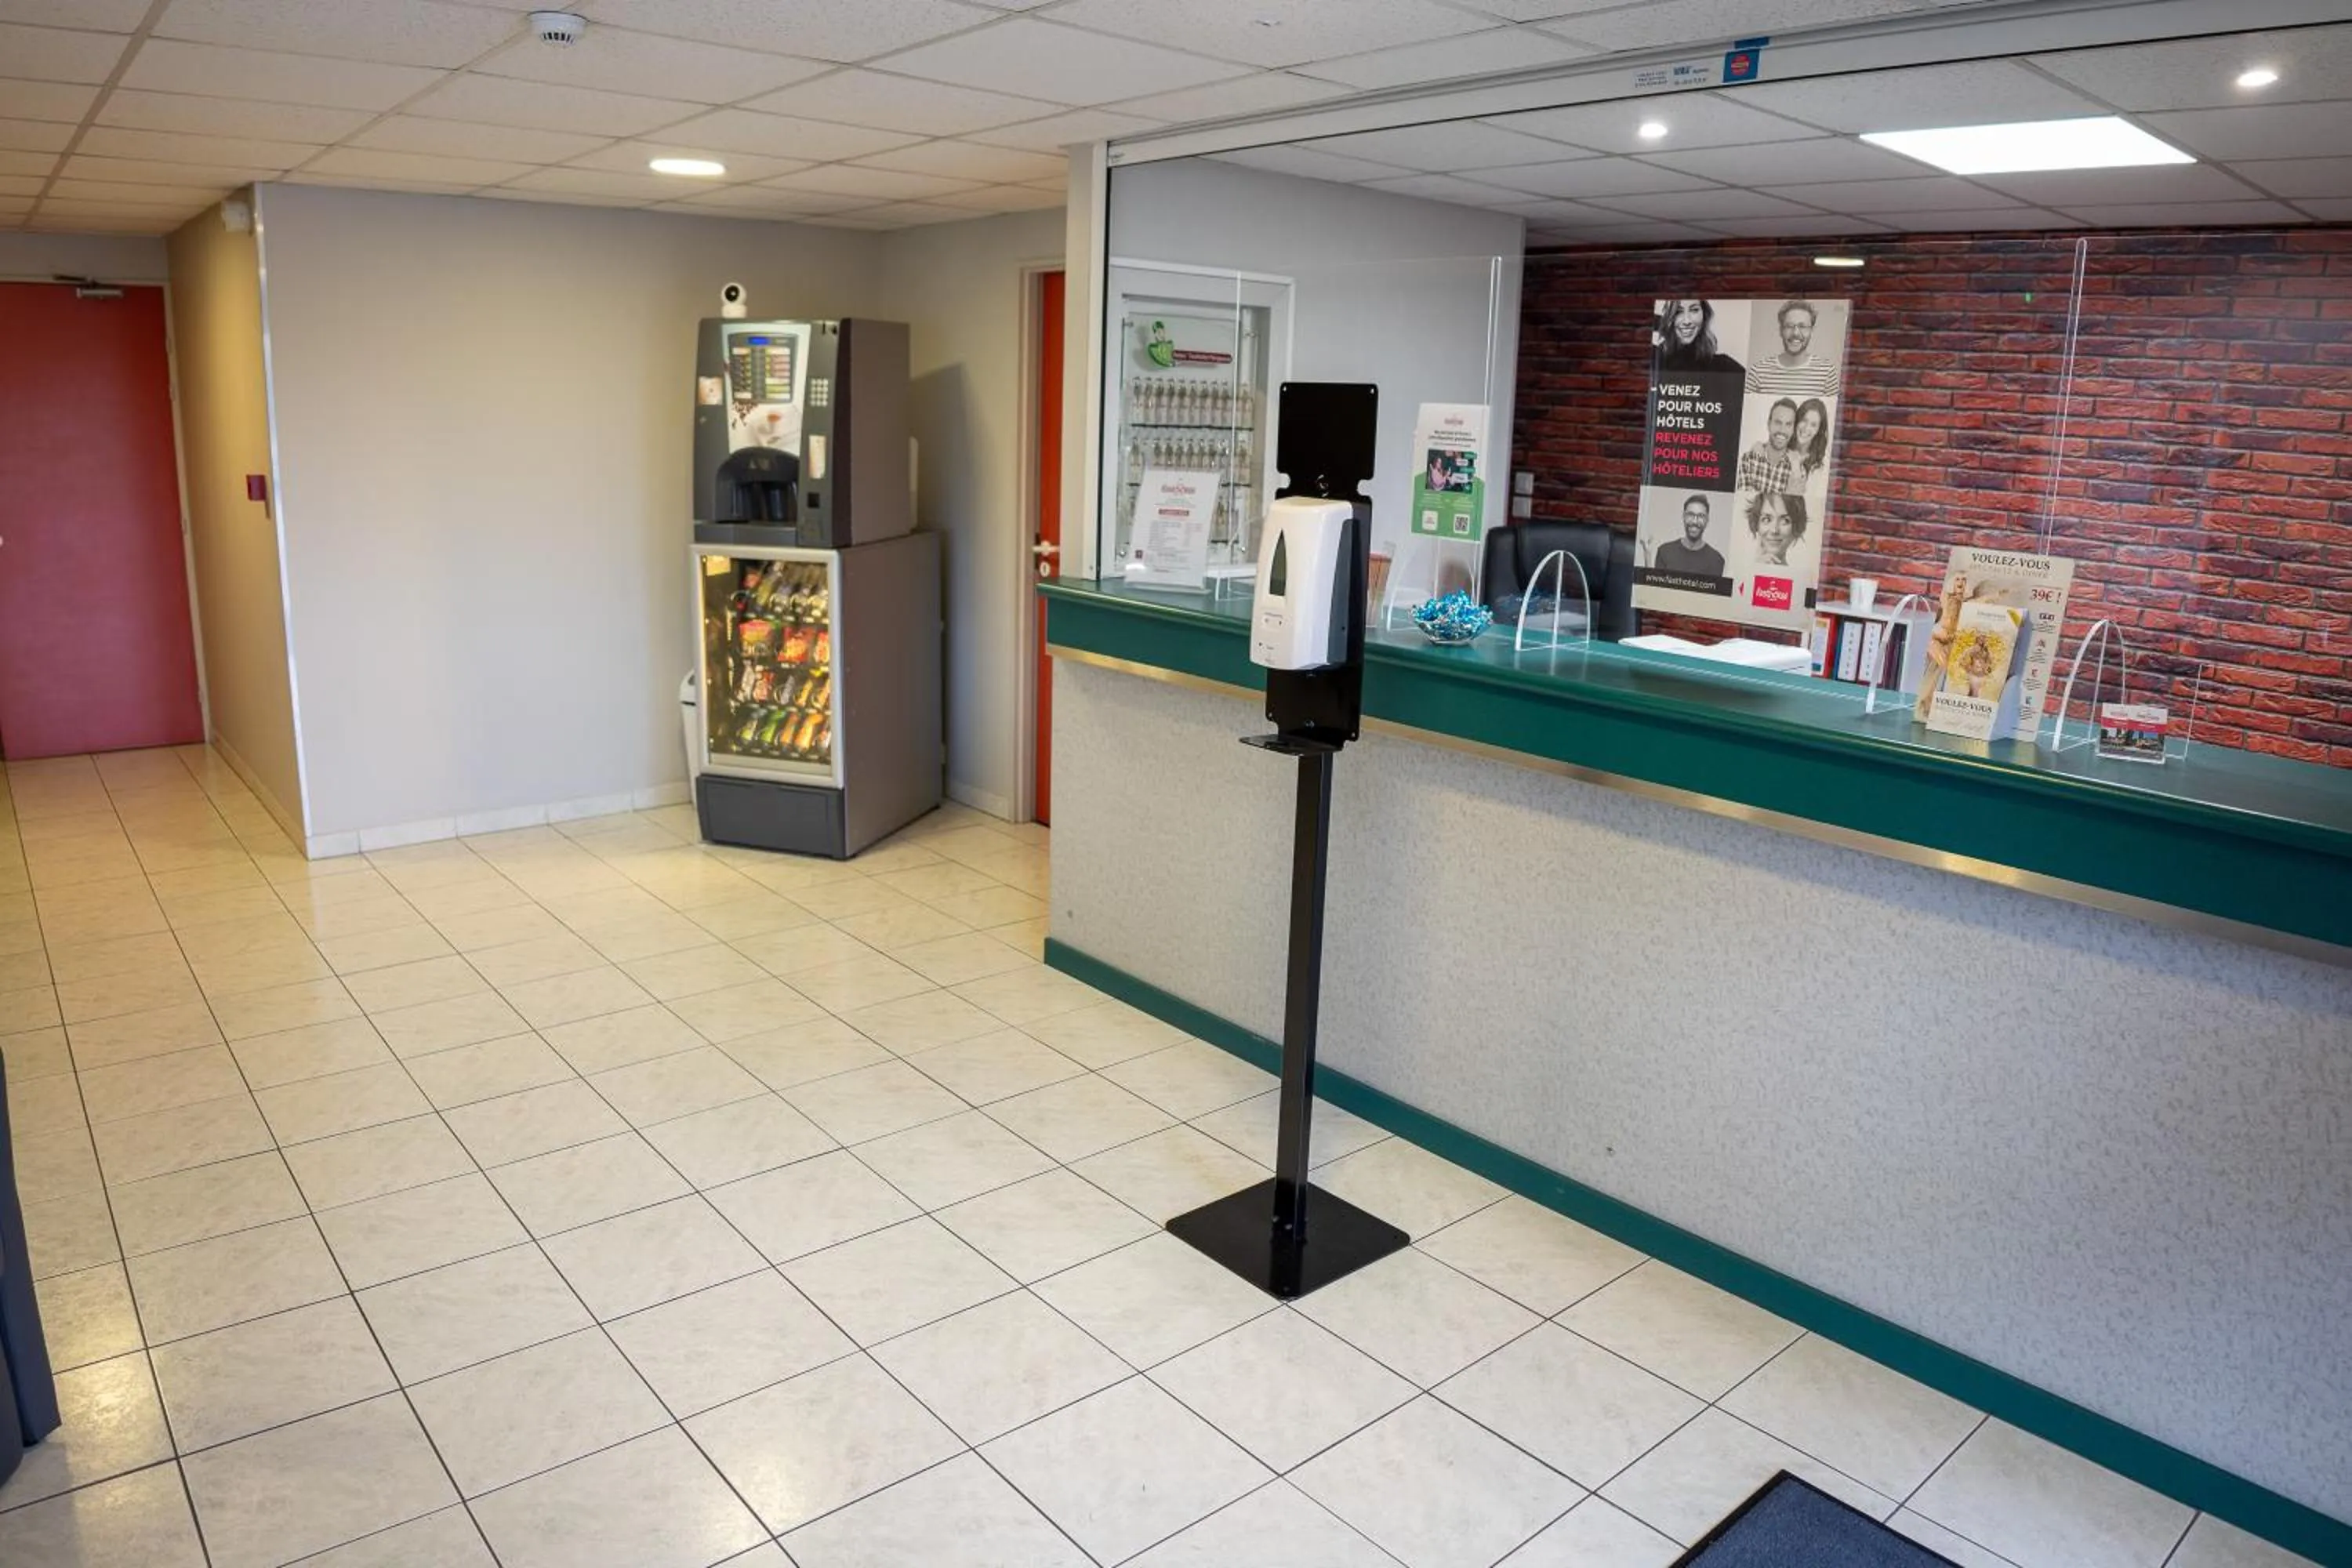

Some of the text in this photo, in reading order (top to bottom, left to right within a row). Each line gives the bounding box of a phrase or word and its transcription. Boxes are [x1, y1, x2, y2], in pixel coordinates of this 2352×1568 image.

[1659, 383, 1700, 396] VENEZ
[1657, 400, 1722, 414] POUR NOS
[1657, 414, 1704, 429] HÔTELS
[1655, 432, 1713, 445] REVENEZ
[1653, 448, 1719, 462] POUR NOS
[1652, 461, 1719, 478] HÔTELIERS
[1972, 553, 2050, 570] VOULEZ-VOUS
[2031, 589, 2053, 602] 39€
